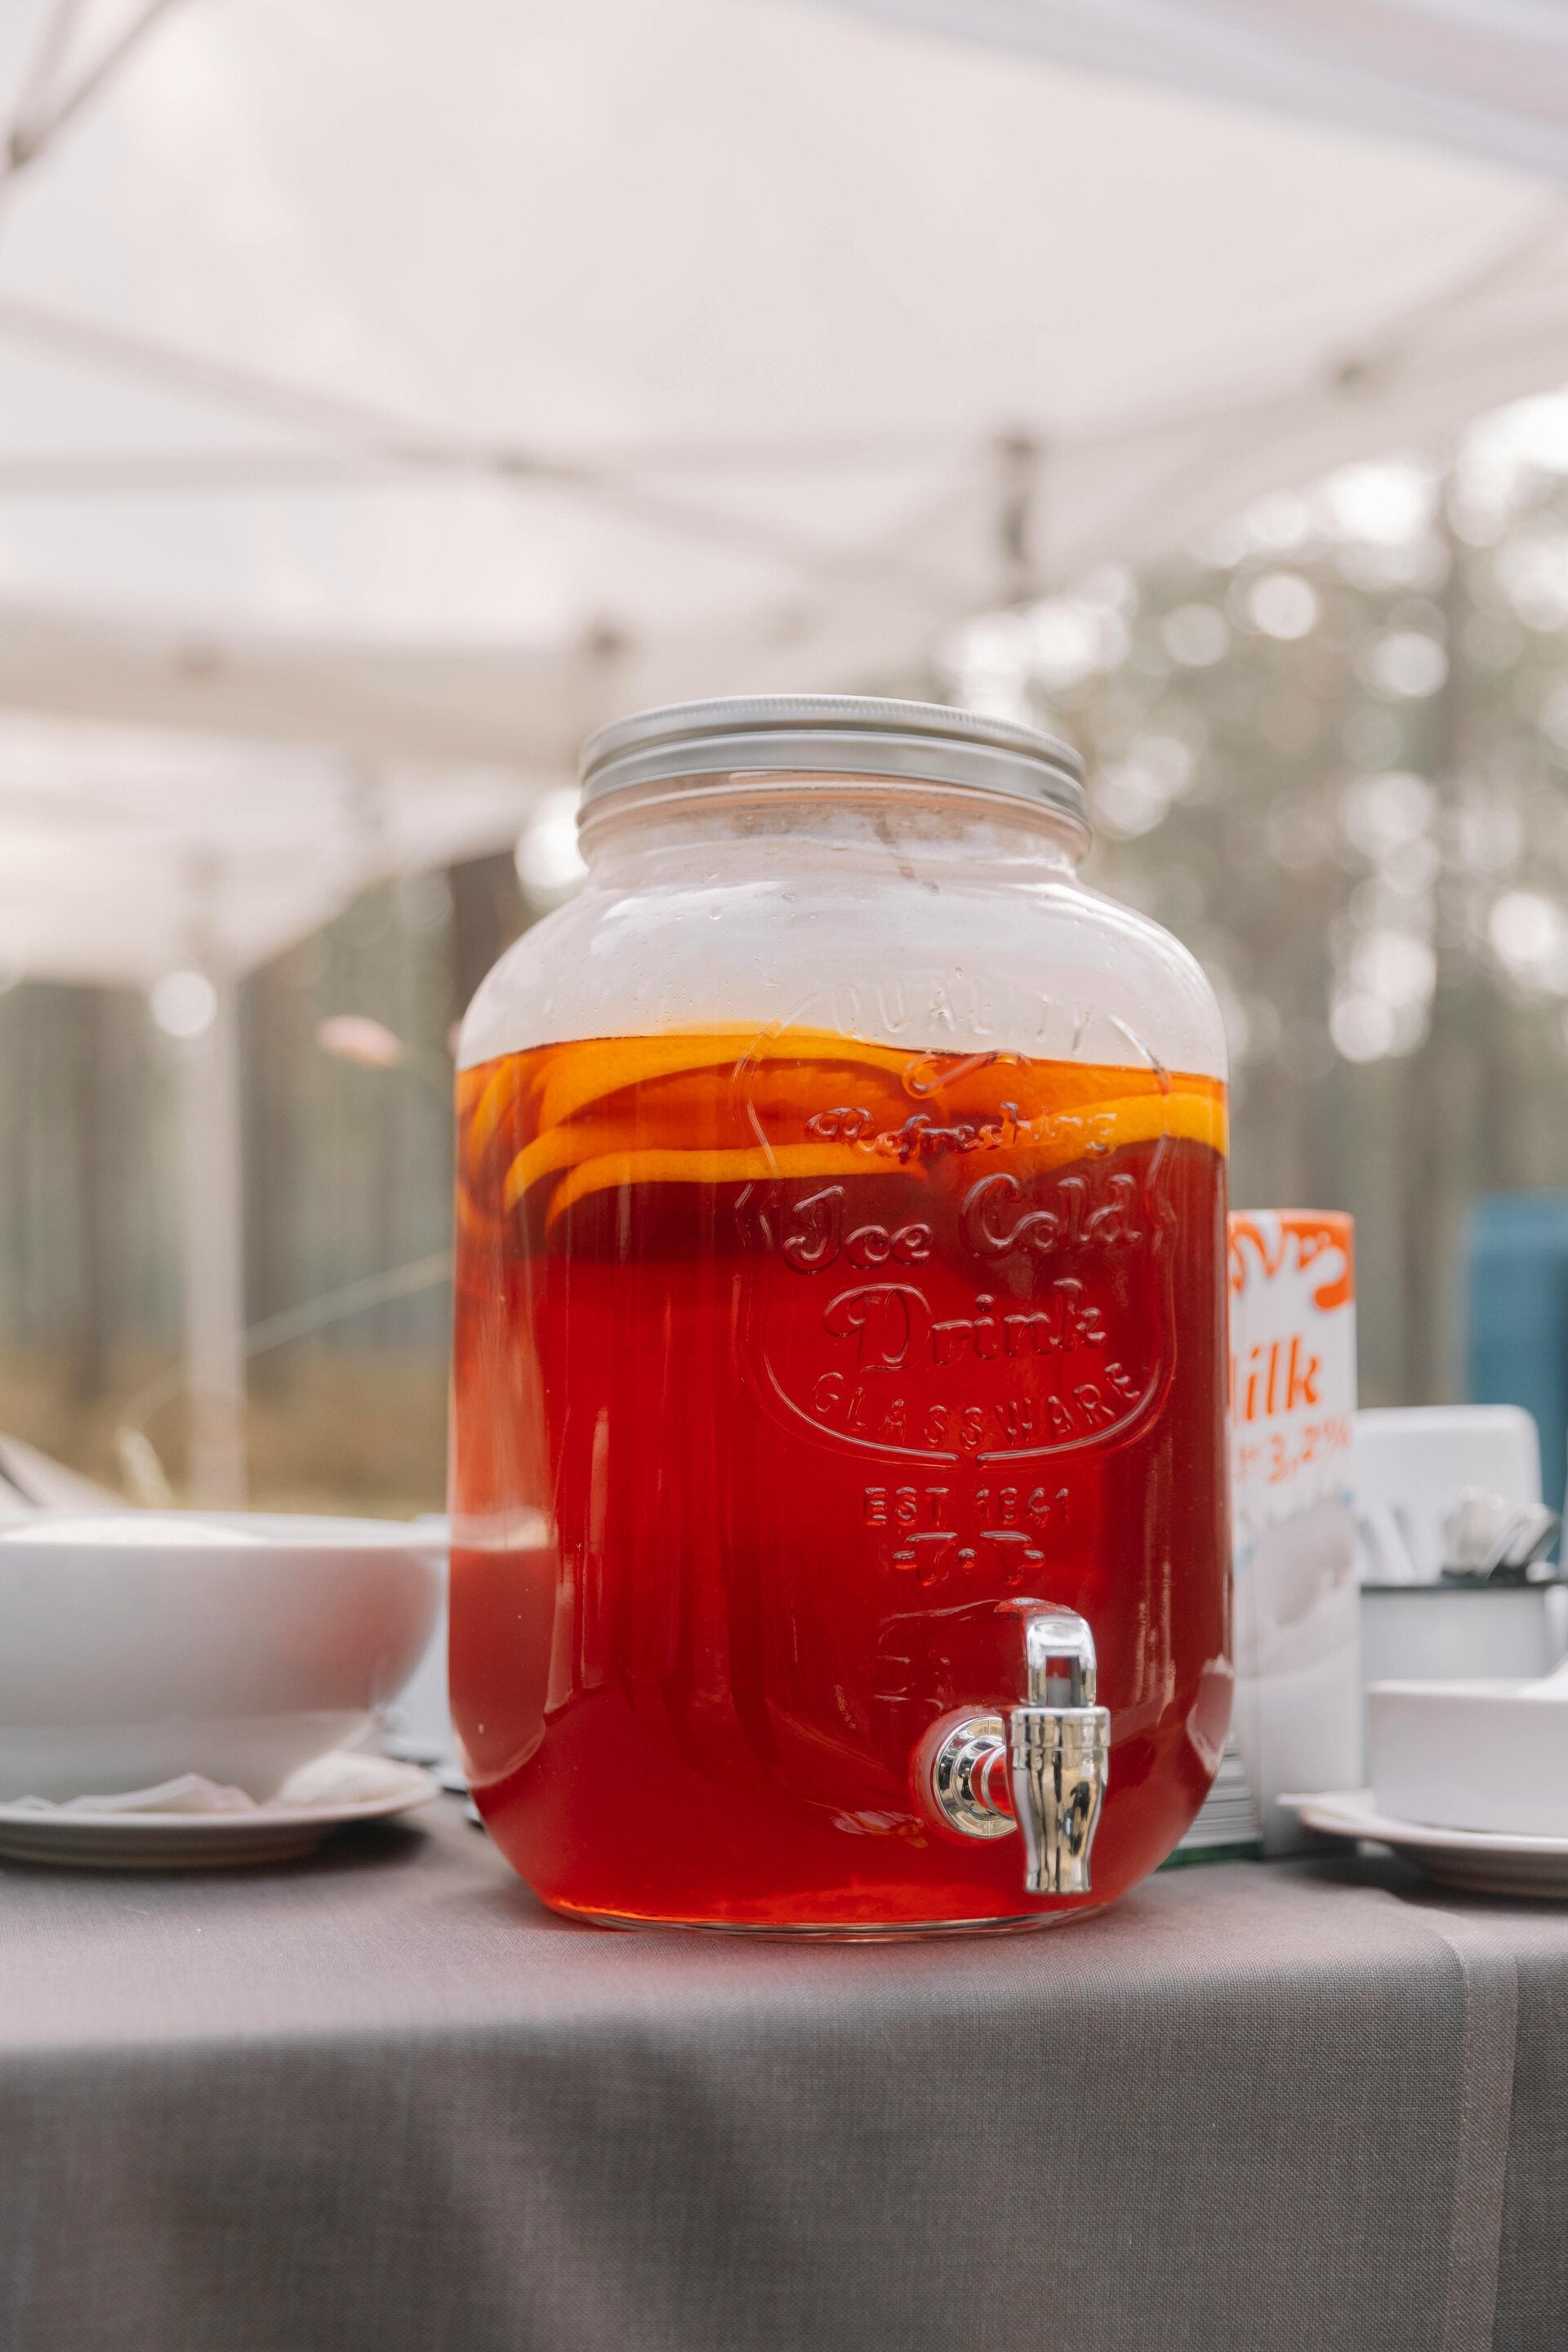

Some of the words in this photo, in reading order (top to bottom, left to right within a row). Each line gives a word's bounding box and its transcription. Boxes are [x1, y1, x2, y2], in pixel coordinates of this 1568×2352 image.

[959, 1173, 1143, 1257] Cold
[822, 1277, 1109, 1371] Drink
[812, 1361, 1142, 1450] GLASSWARE
[1231, 1334, 1319, 1424] ilk
[864, 1486, 951, 1526] EST
